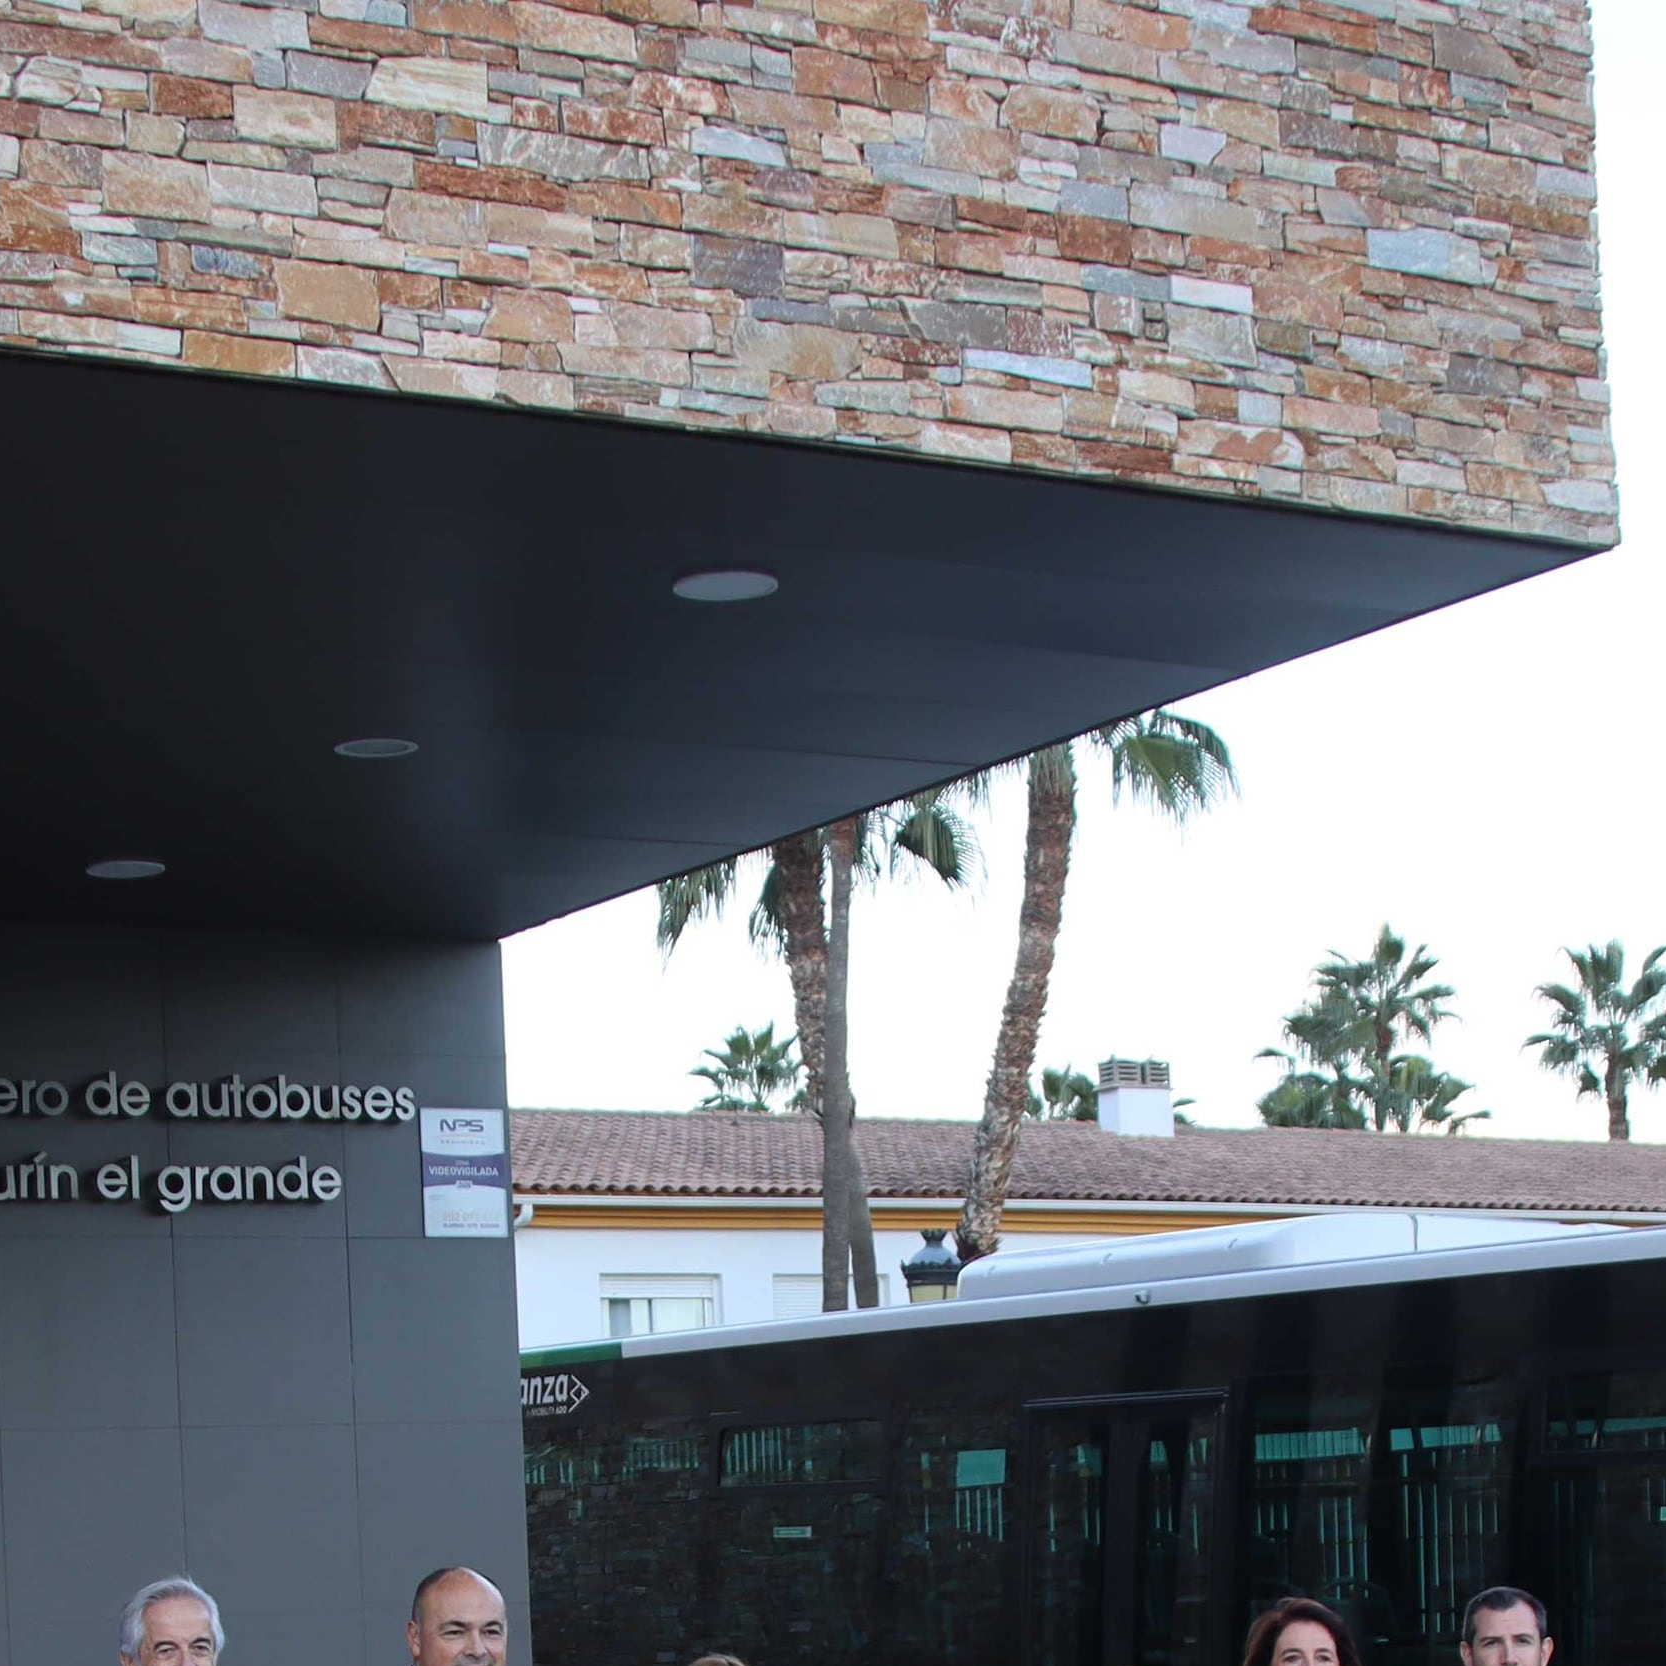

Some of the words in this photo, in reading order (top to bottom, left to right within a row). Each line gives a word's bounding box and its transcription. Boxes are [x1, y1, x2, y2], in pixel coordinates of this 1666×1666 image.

[85, 1070, 151, 1117] de
[165, 1074, 416, 1121] autobuses
[439, 1119, 485, 1132] NPS
[95, 1155, 140, 1201] el
[157, 1156, 343, 1213] grande
[428, 1165, 500, 1177] VIDEOVIGILADA
